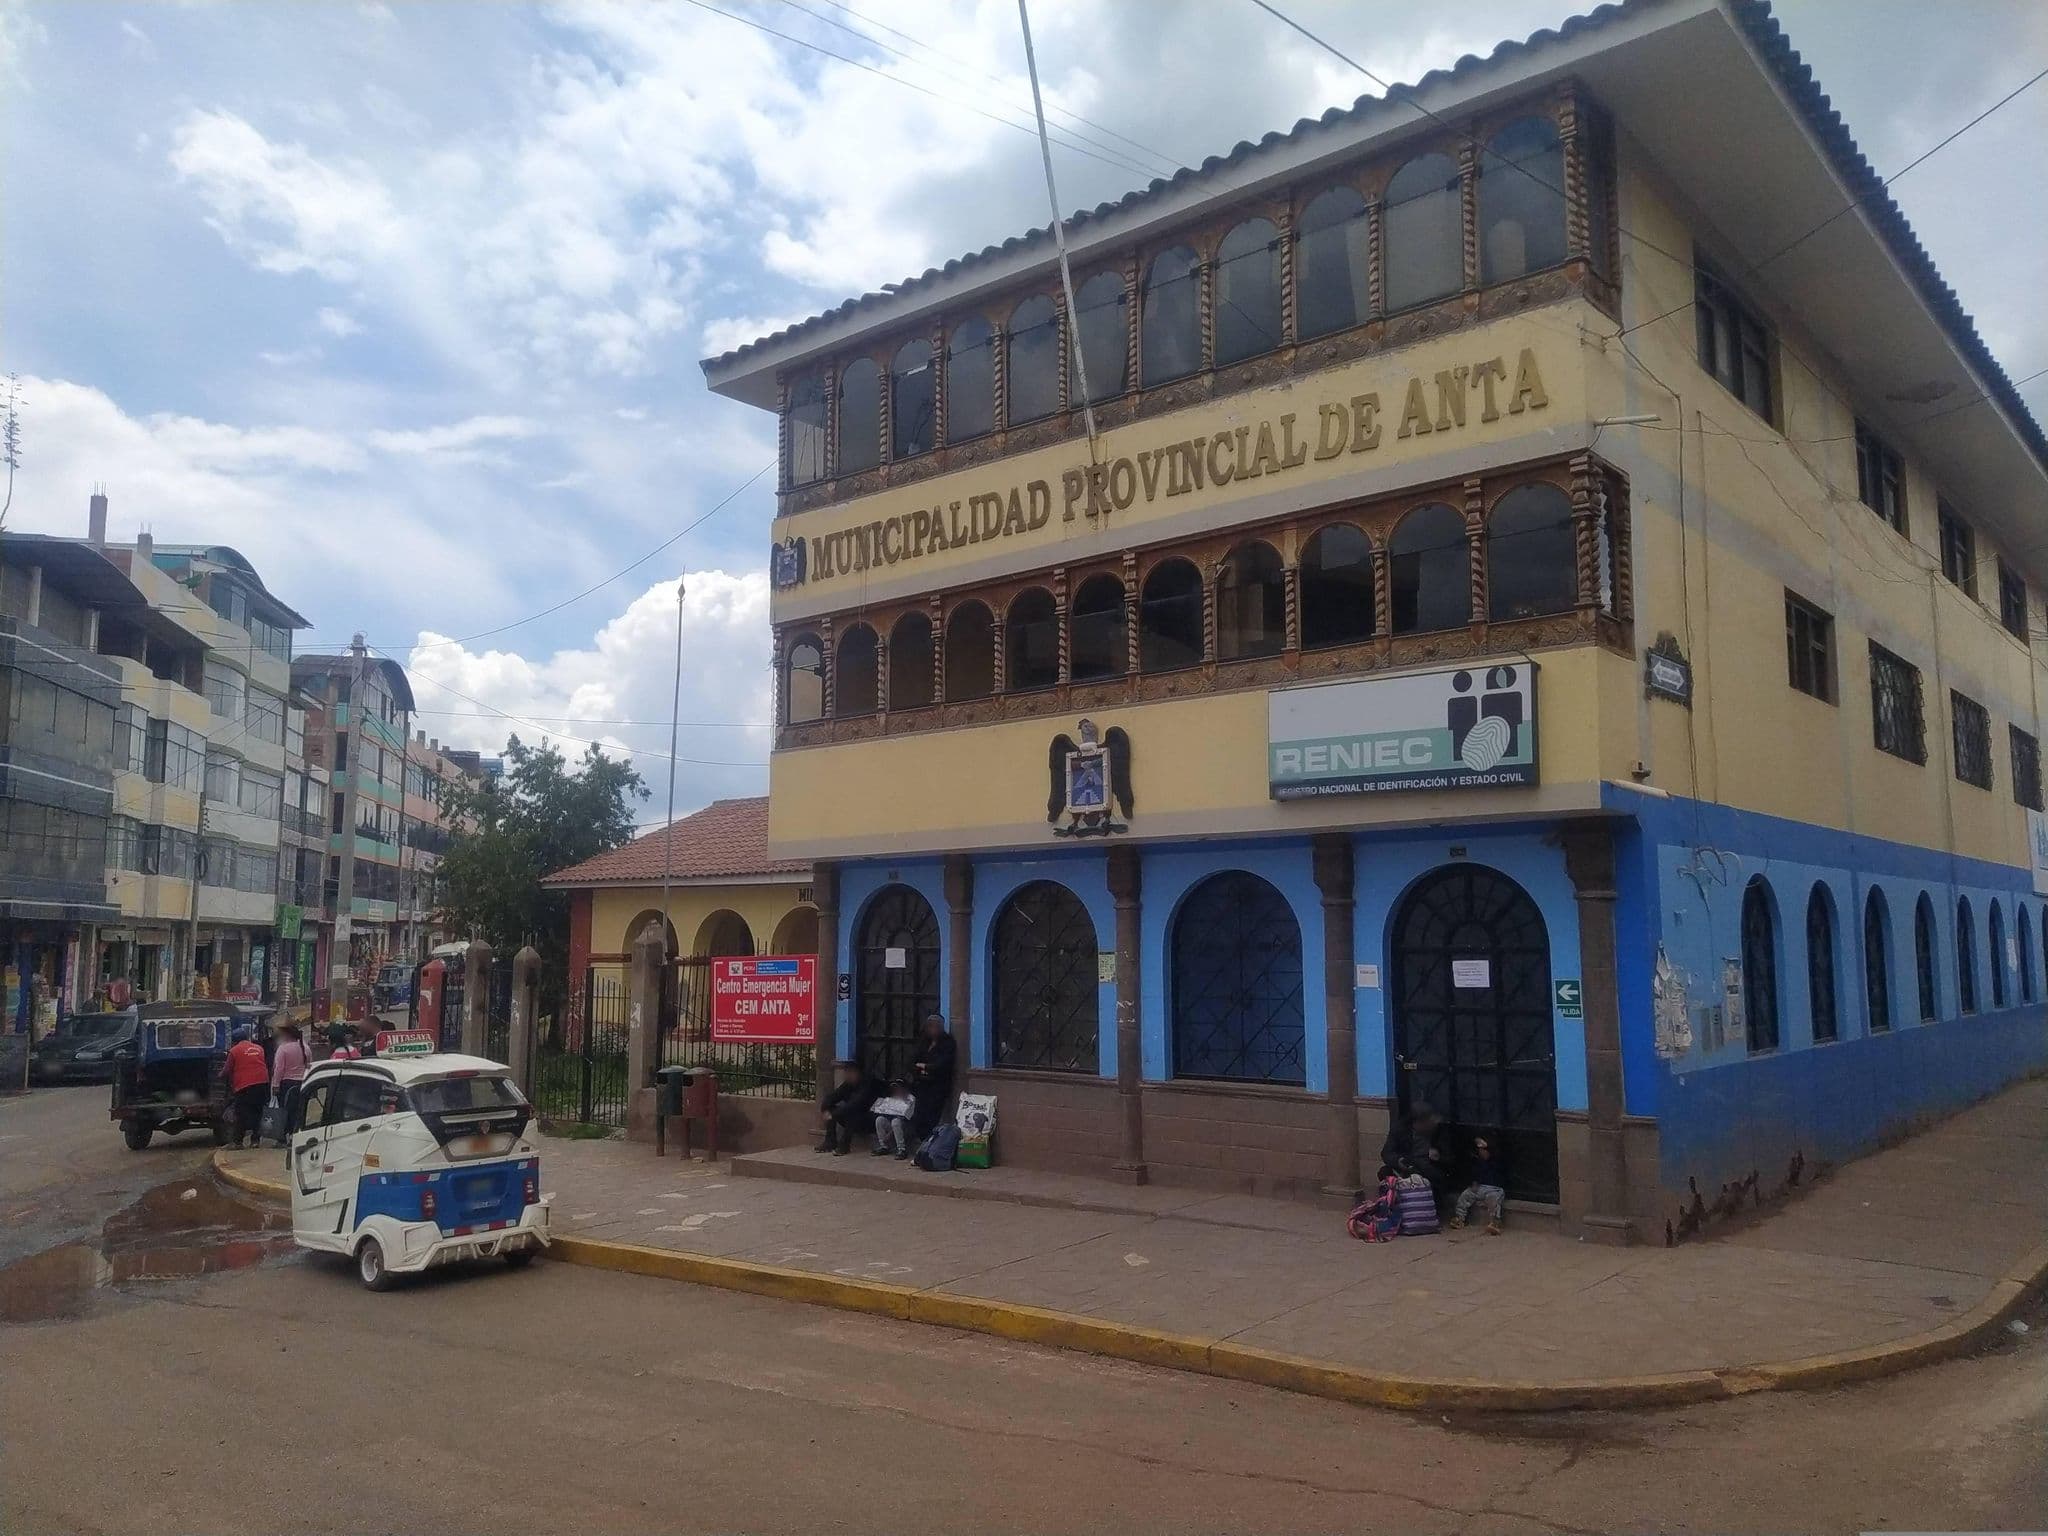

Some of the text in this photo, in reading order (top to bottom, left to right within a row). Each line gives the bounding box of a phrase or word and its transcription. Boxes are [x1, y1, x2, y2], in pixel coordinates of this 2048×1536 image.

[811, 347, 1549, 582] MUNICIPALIDAD PROVINCIAL DE ANTA
[1275, 737, 1432, 774] RENIEC
[1318, 783, 1361, 795] NACIONAL
[1363, 782, 1375, 791] DE
[1377, 776, 1447, 791] IDENTIFICACIÓN
[1451, 777, 1457, 786] Y
[1460, 774, 1497, 785] ESTADO
[1500, 773, 1524, 783] CIVIL
[717, 976, 811, 997] Centro Emergencia Mujer
[735, 999, 791, 1015] CEM ANTA
[795, 1027, 811, 1036] PISO
